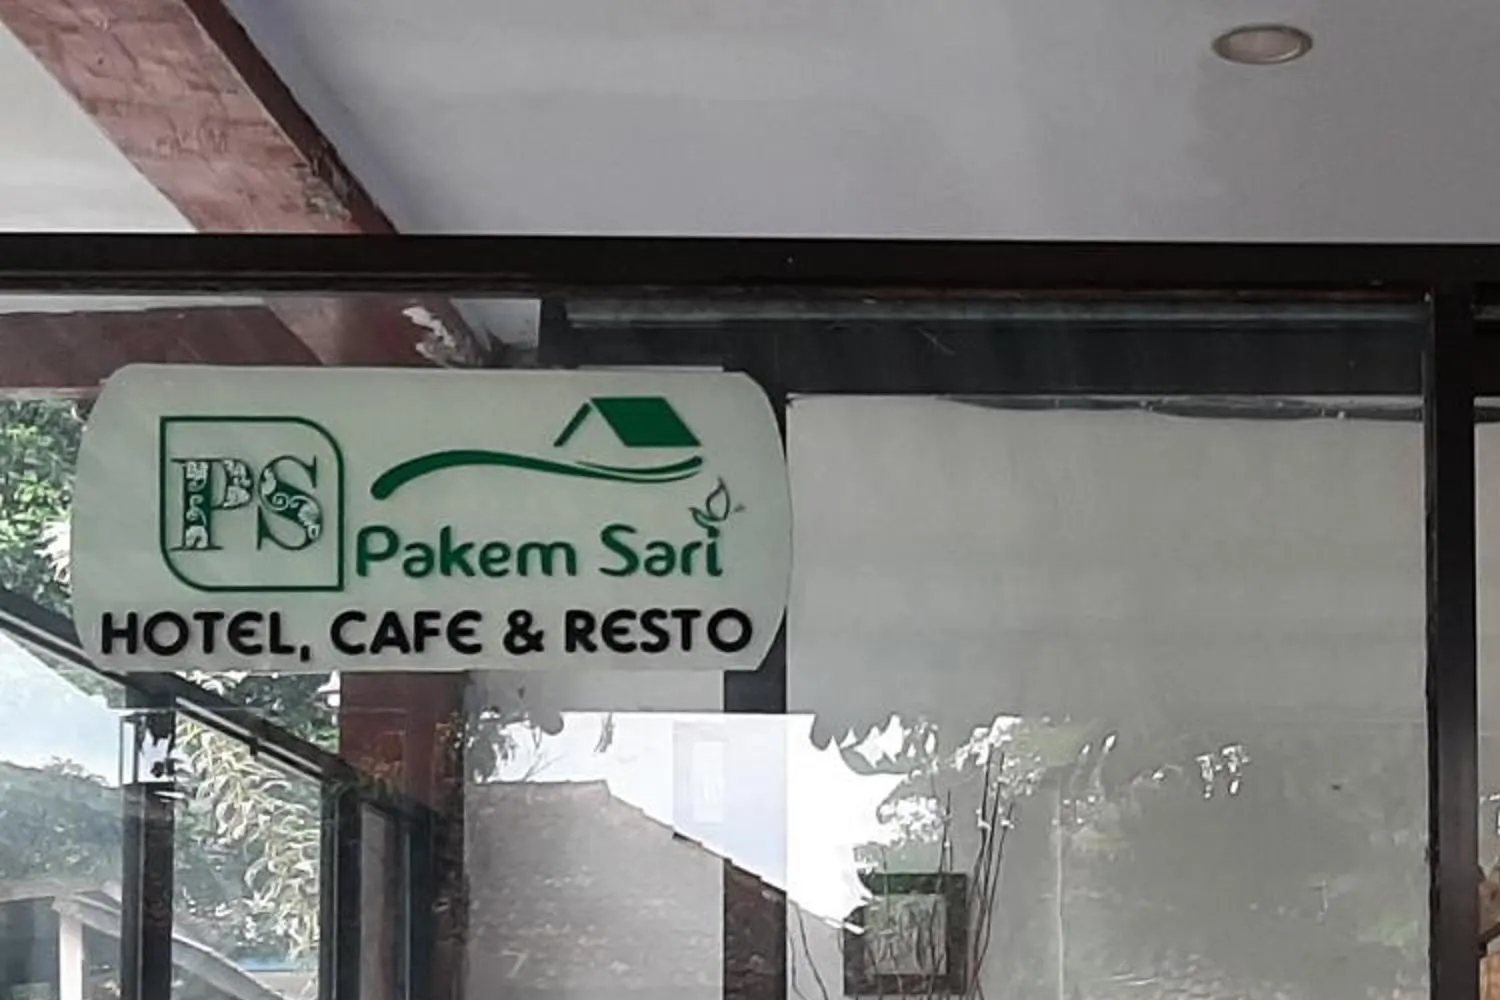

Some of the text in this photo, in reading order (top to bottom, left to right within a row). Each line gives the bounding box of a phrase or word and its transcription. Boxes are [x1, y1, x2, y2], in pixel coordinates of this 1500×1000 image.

[169, 454, 323, 553] PS
[355, 522, 723, 579] Pakem Sari
[100, 607, 754, 663] HOTEL, CAFE & RESTO
